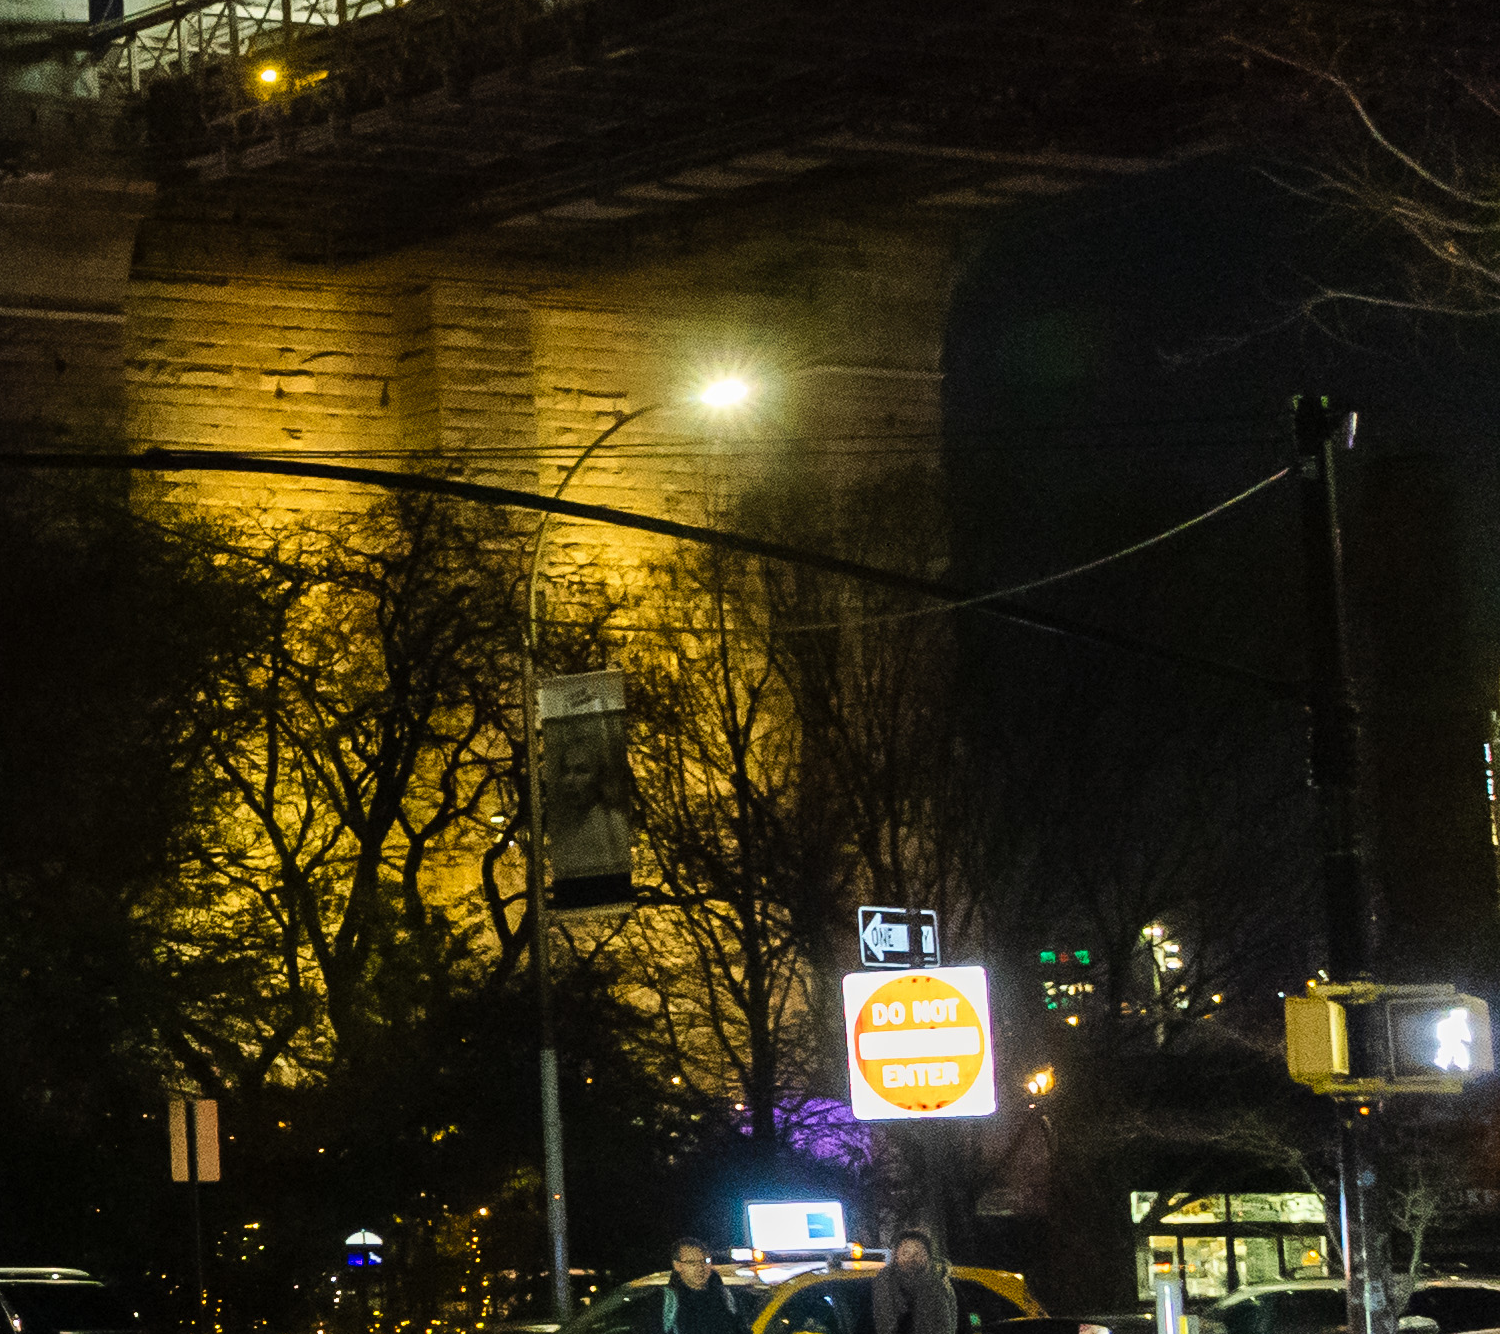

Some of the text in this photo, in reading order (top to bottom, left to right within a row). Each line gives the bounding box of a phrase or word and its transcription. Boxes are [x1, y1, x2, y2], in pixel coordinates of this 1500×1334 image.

[871, 927, 894, 948] ONE
[871, 998, 960, 1026] DO NOT
[882, 1061, 960, 1088] ENTER
